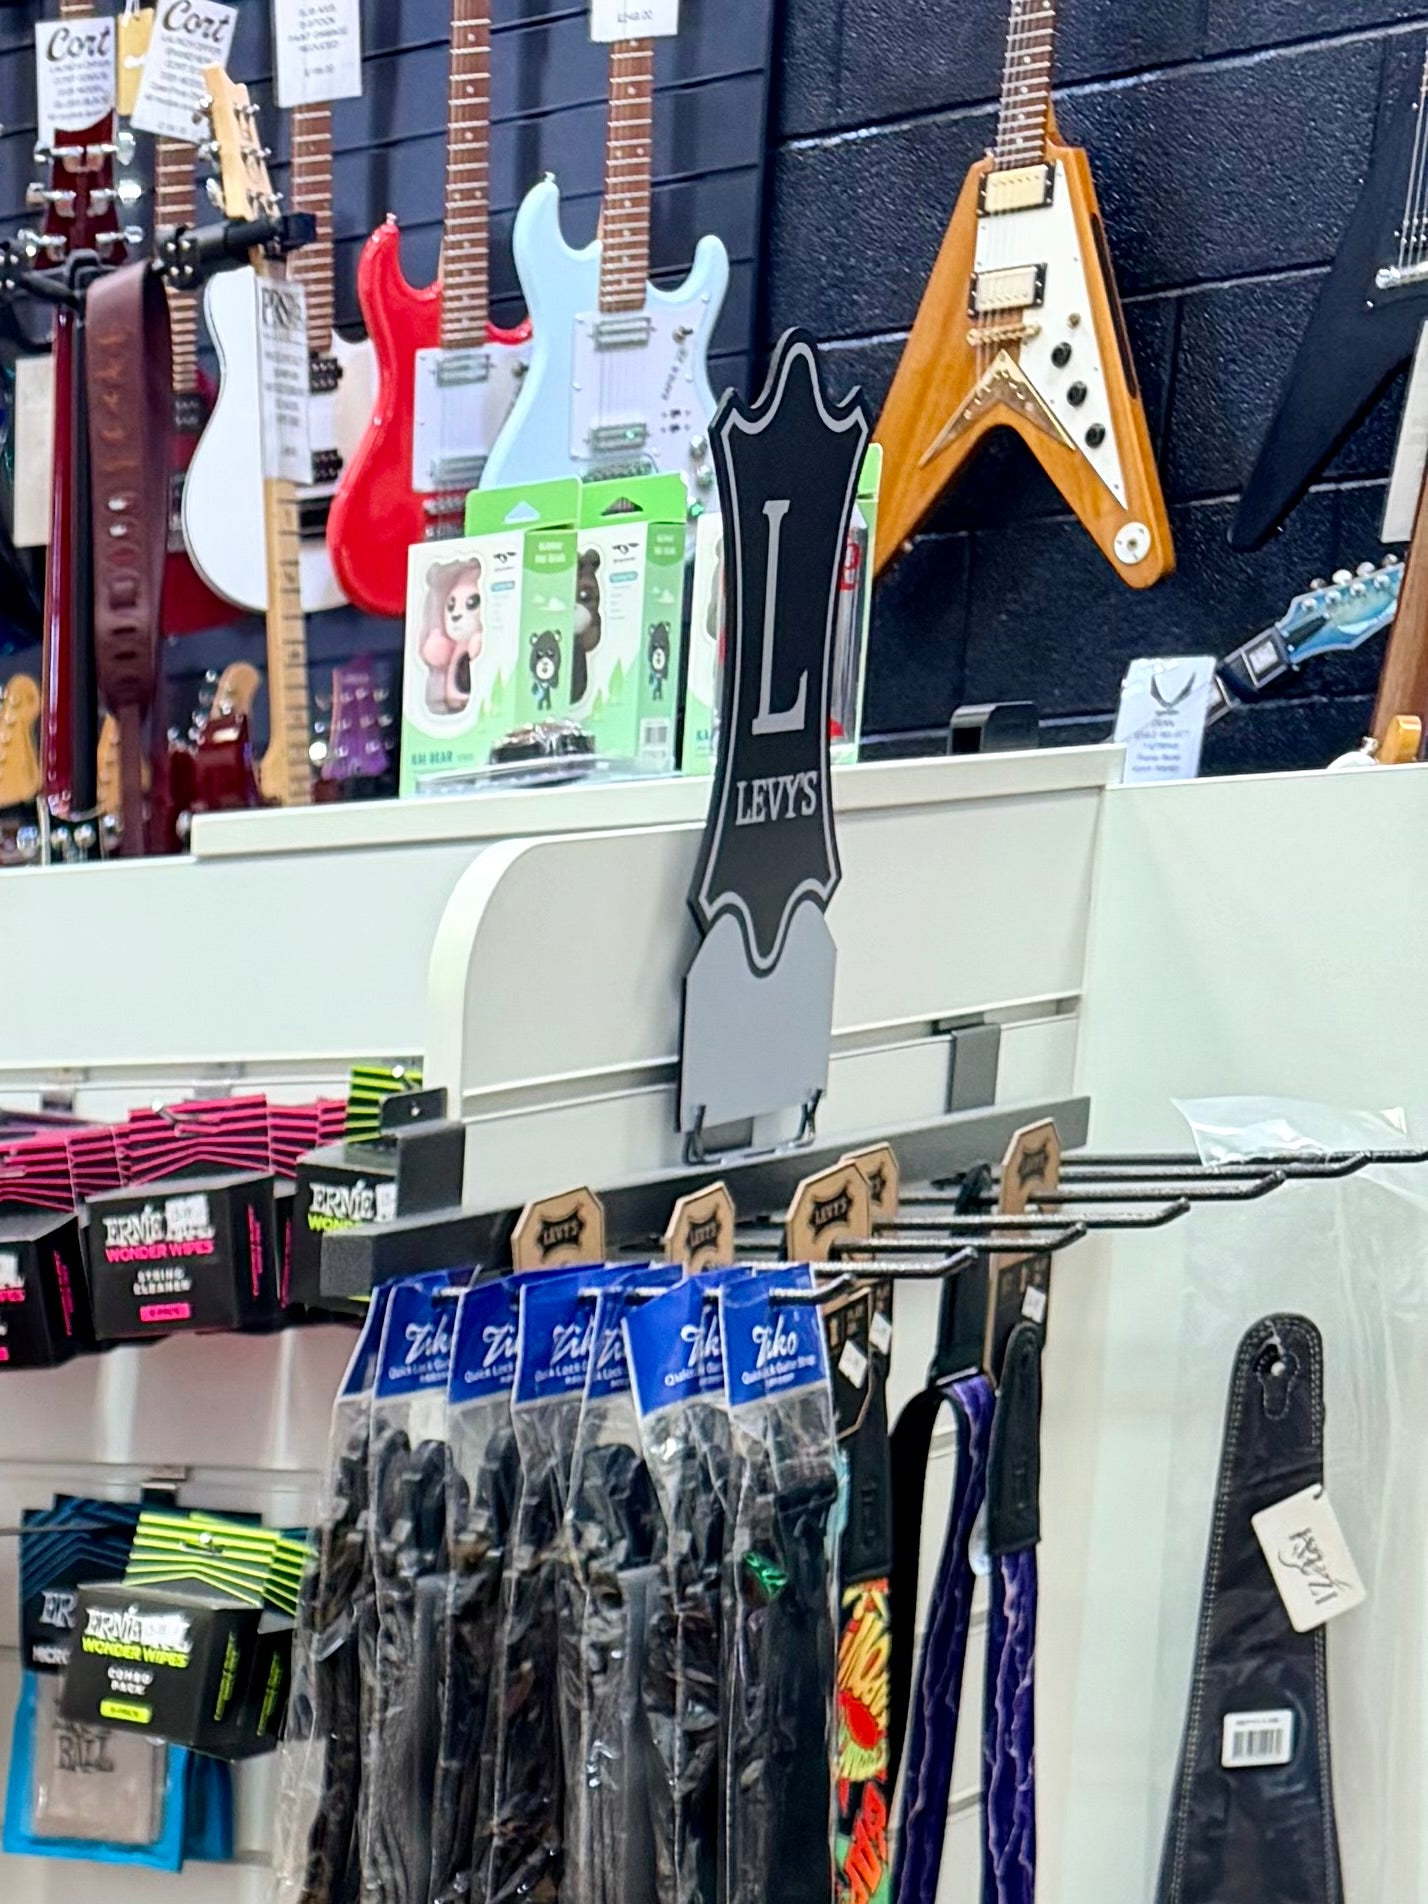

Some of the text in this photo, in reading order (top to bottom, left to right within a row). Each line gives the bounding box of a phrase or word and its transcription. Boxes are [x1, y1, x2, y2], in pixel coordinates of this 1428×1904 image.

[47, 22, 111, 62] Cort
[735, 770, 819, 826] LEVY'S
[105, 1239, 215, 1265] WONDER WIPES
[82, 1634, 190, 1669] WONDER WIPES
[111, 1678, 146, 1697] PACK
